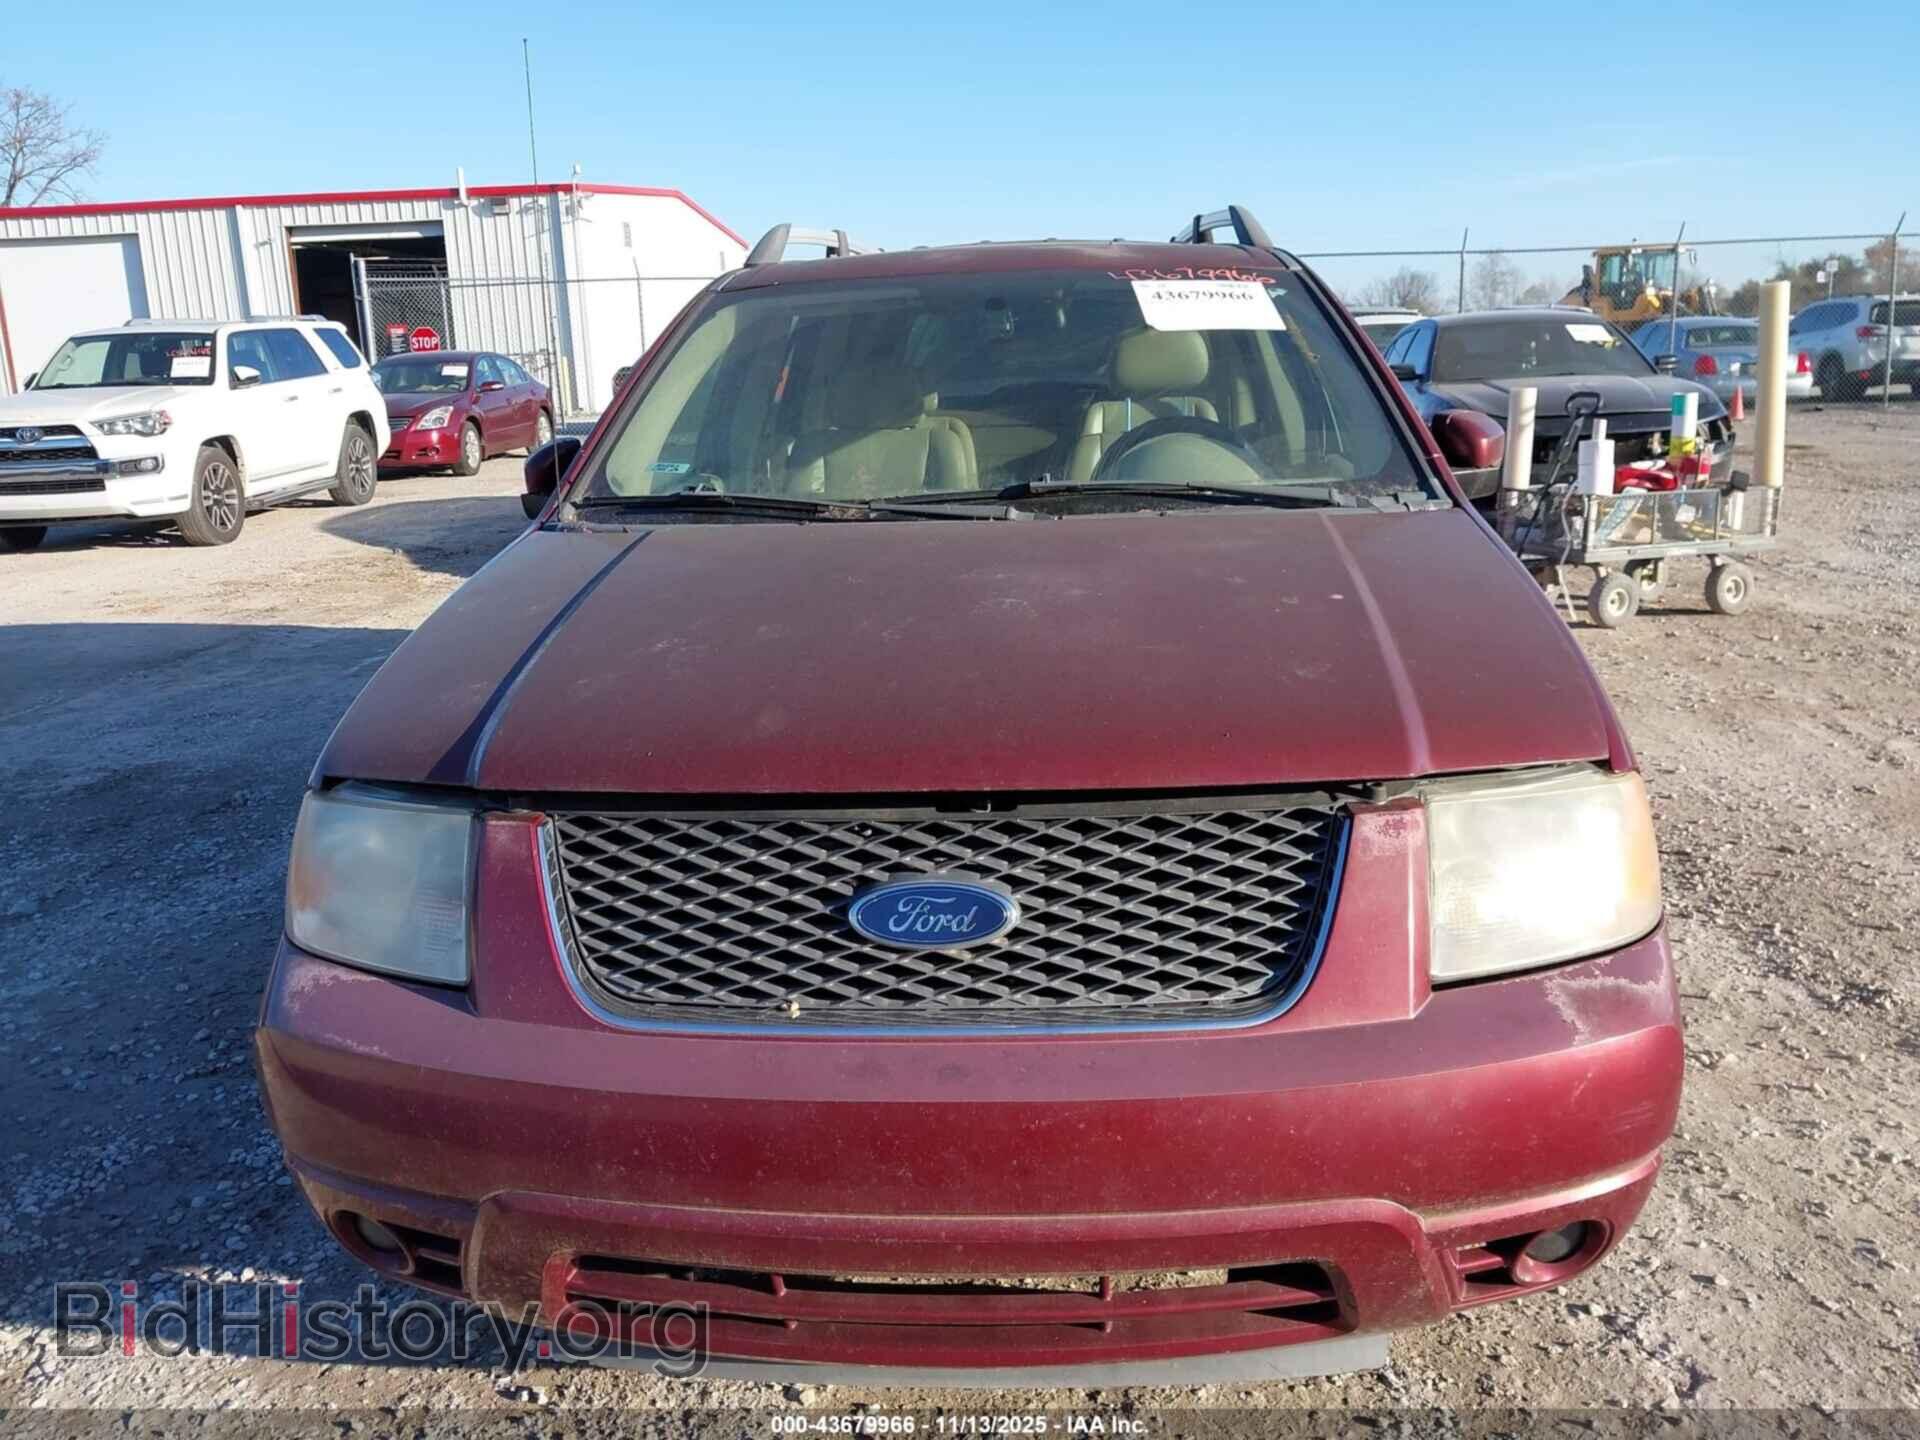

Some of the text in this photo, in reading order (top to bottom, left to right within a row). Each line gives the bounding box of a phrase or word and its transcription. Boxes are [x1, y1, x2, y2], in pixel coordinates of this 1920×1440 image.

[1152, 290, 1255, 301] 43679966
[412, 336, 439, 350] STOP
[888, 895, 979, 933] Ford
